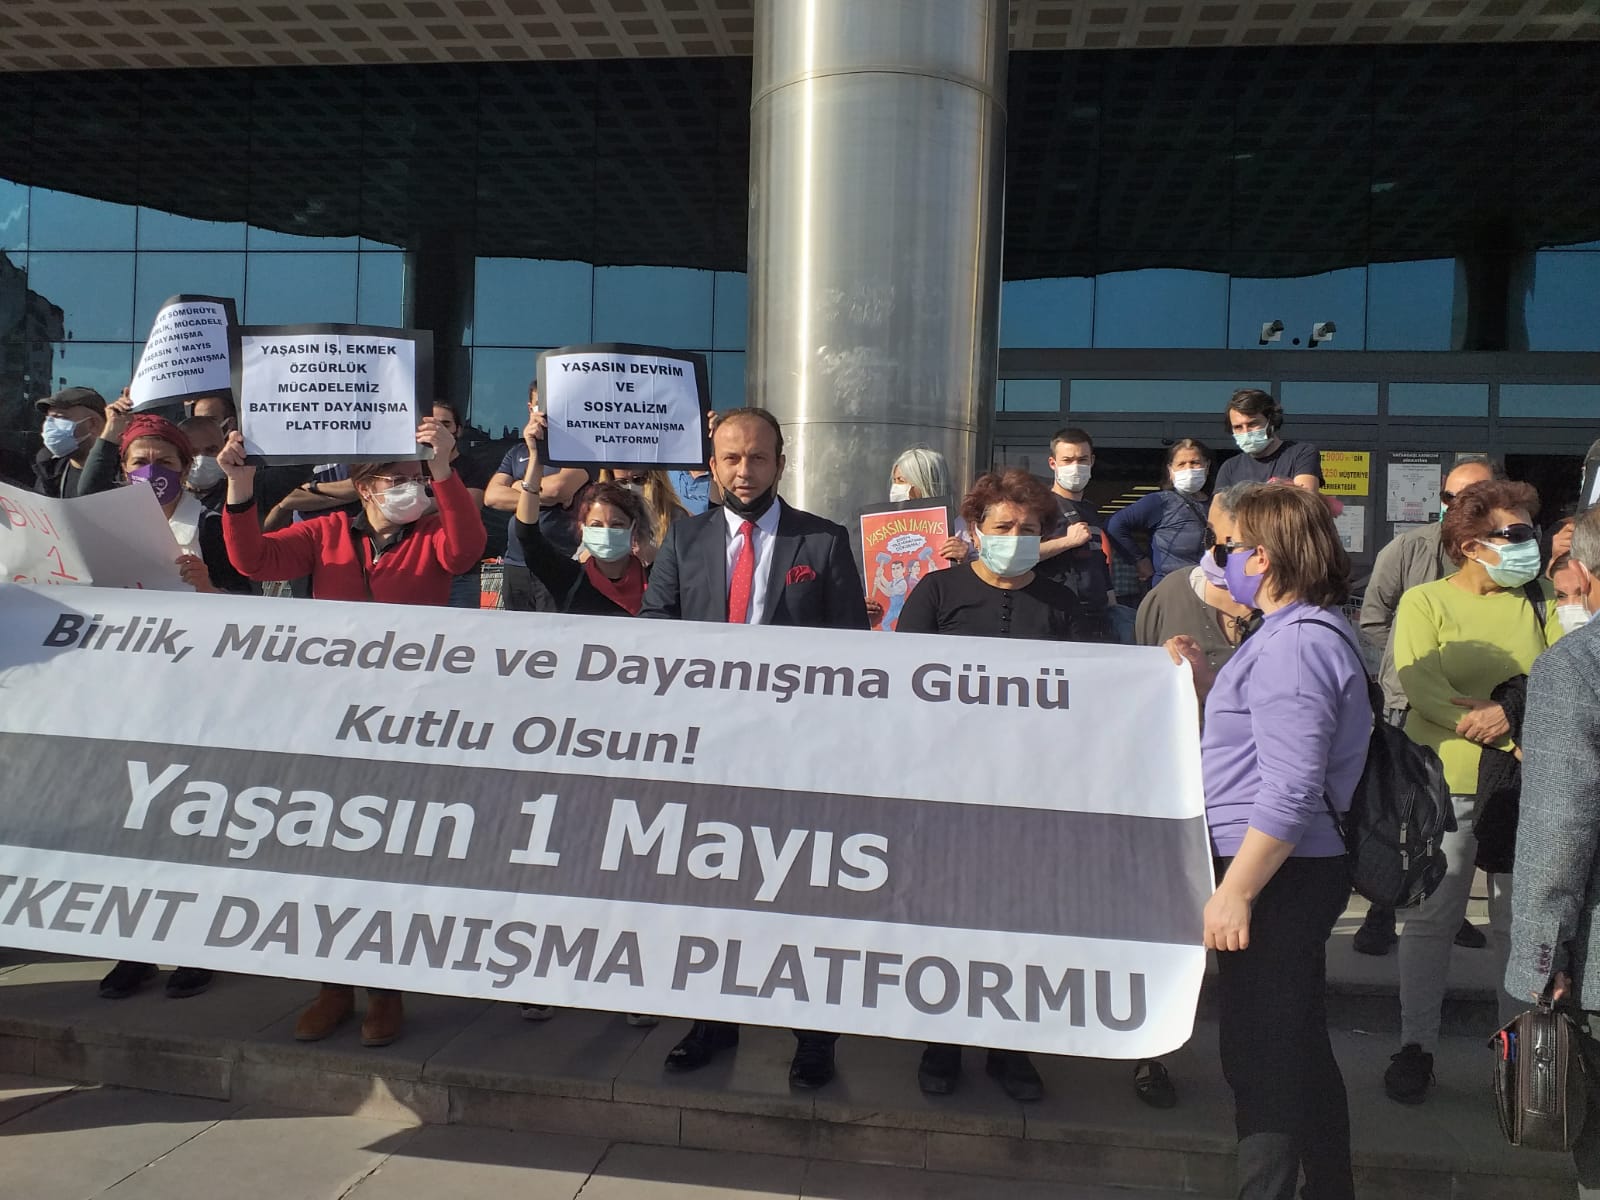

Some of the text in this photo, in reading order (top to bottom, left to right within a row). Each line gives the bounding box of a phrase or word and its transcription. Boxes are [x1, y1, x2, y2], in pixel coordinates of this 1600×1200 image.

[174, 318, 223, 329] MÜCADELE
[155, 330, 204, 346] DAYANIŞMA
[182, 342, 212, 352] MAYIS
[261, 341, 397, 356] YAŞASIN İŞ, EKMEK
[171, 352, 226, 367] DAYANIŞMA
[151, 367, 205, 382] PLATFORMU
[289, 361, 367, 374] ÖZGÜRLÜK
[562, 361, 683, 377] YAŞASIN DEVRİM
[278, 381, 380, 393] MÜCADELEMİZ
[615, 381, 635, 393] VE
[249, 402, 408, 414] BATIKENT DAYANIŞMA
[584, 399, 667, 414] SOSYALİZM
[286, 420, 371, 430] PLATFORMU
[566, 420, 685, 432] BATIKENT DAYANIŞMA
[595, 435, 659, 445] PLATFORMU
[47, 545, 79, 581] 1
[42, 613, 1071, 710] Birlik, Mücadele ve Dayanışma Günü
[336, 704, 702, 765] Kutlu Olsun!
[122, 760, 890, 903] Yaşasın 1 Mayıs
[204, 895, 645, 989] DAYANIŞMA
[671, 935, 1149, 1032] PLATFORMU
